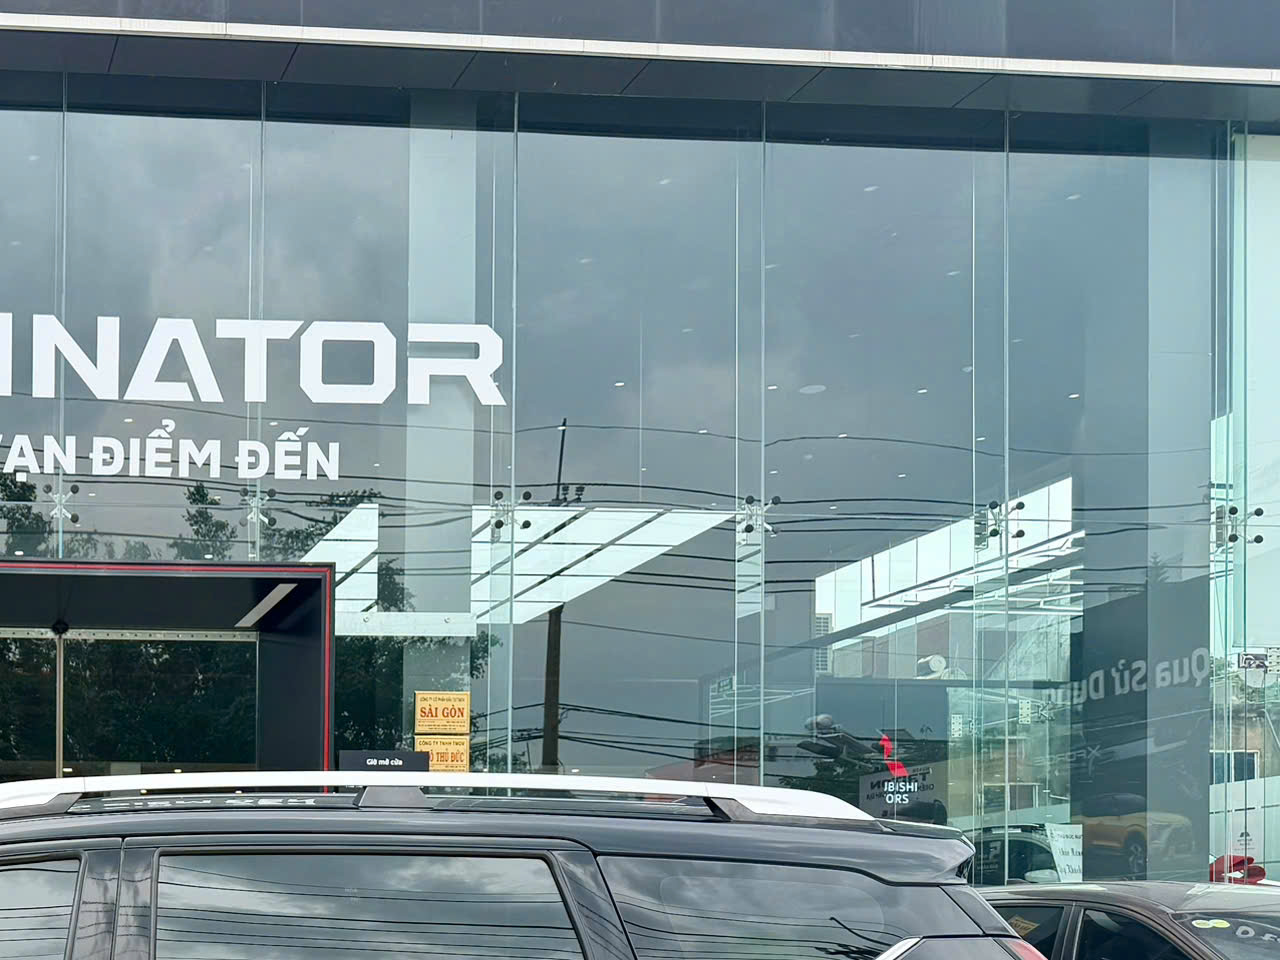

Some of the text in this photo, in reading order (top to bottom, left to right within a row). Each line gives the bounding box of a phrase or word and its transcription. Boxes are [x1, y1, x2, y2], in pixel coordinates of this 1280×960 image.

[89, 419, 221, 478] ĐIỂM
[235, 427, 340, 480] ĐẾN
[419, 704, 465, 718] SÀI GÒN
